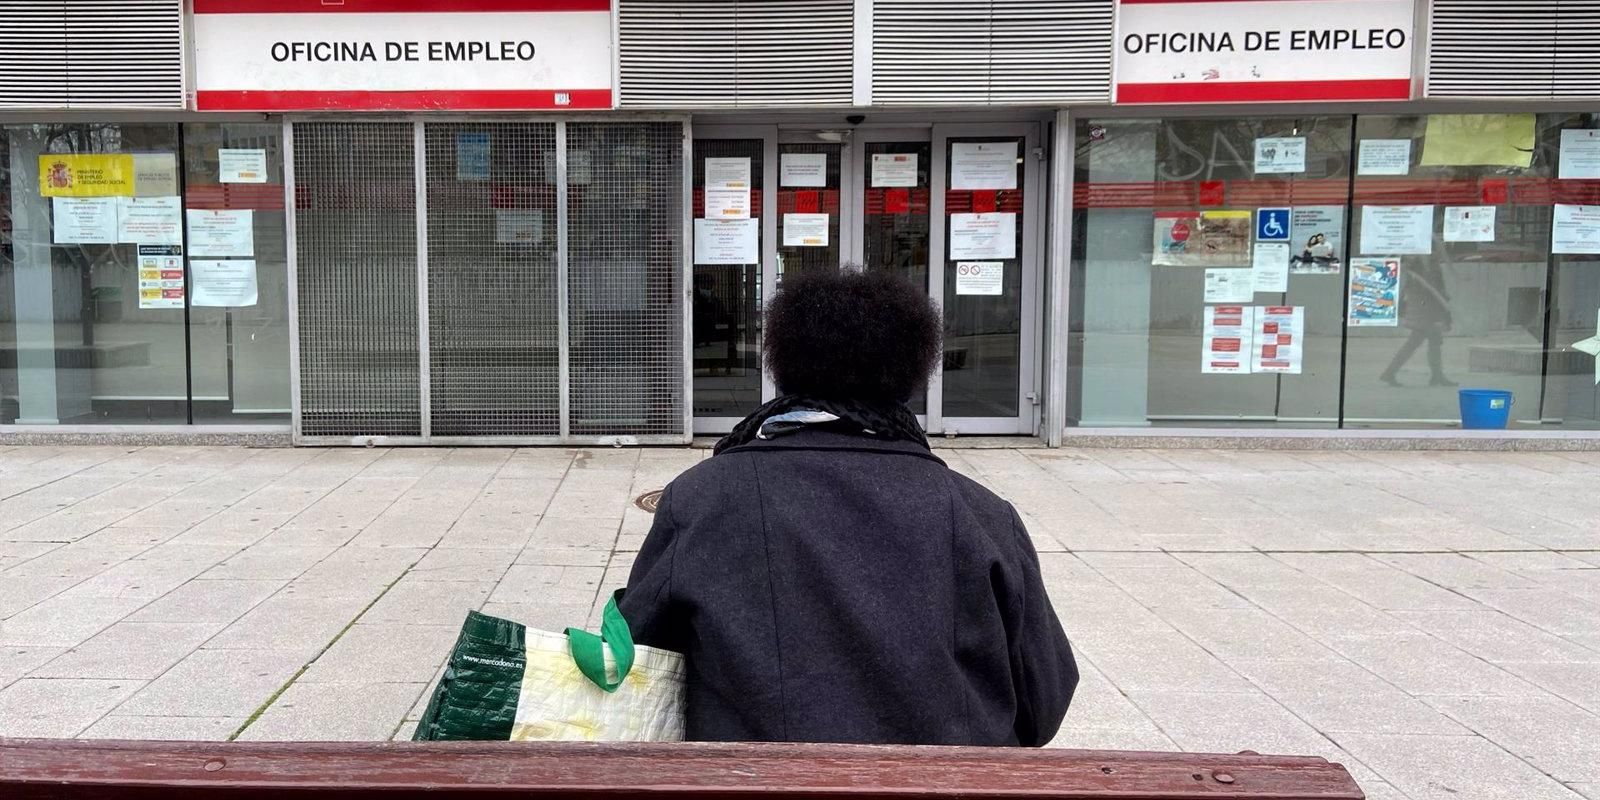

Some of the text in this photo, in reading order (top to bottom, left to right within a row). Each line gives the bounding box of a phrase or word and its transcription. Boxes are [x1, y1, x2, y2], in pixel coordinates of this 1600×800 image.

[271, 40, 535, 62] OFICINA DE EMPLEO
[1123, 28, 1406, 54] OFICINA DE EMPLEO
[462, 654, 523, 669] www.mercadona.es
